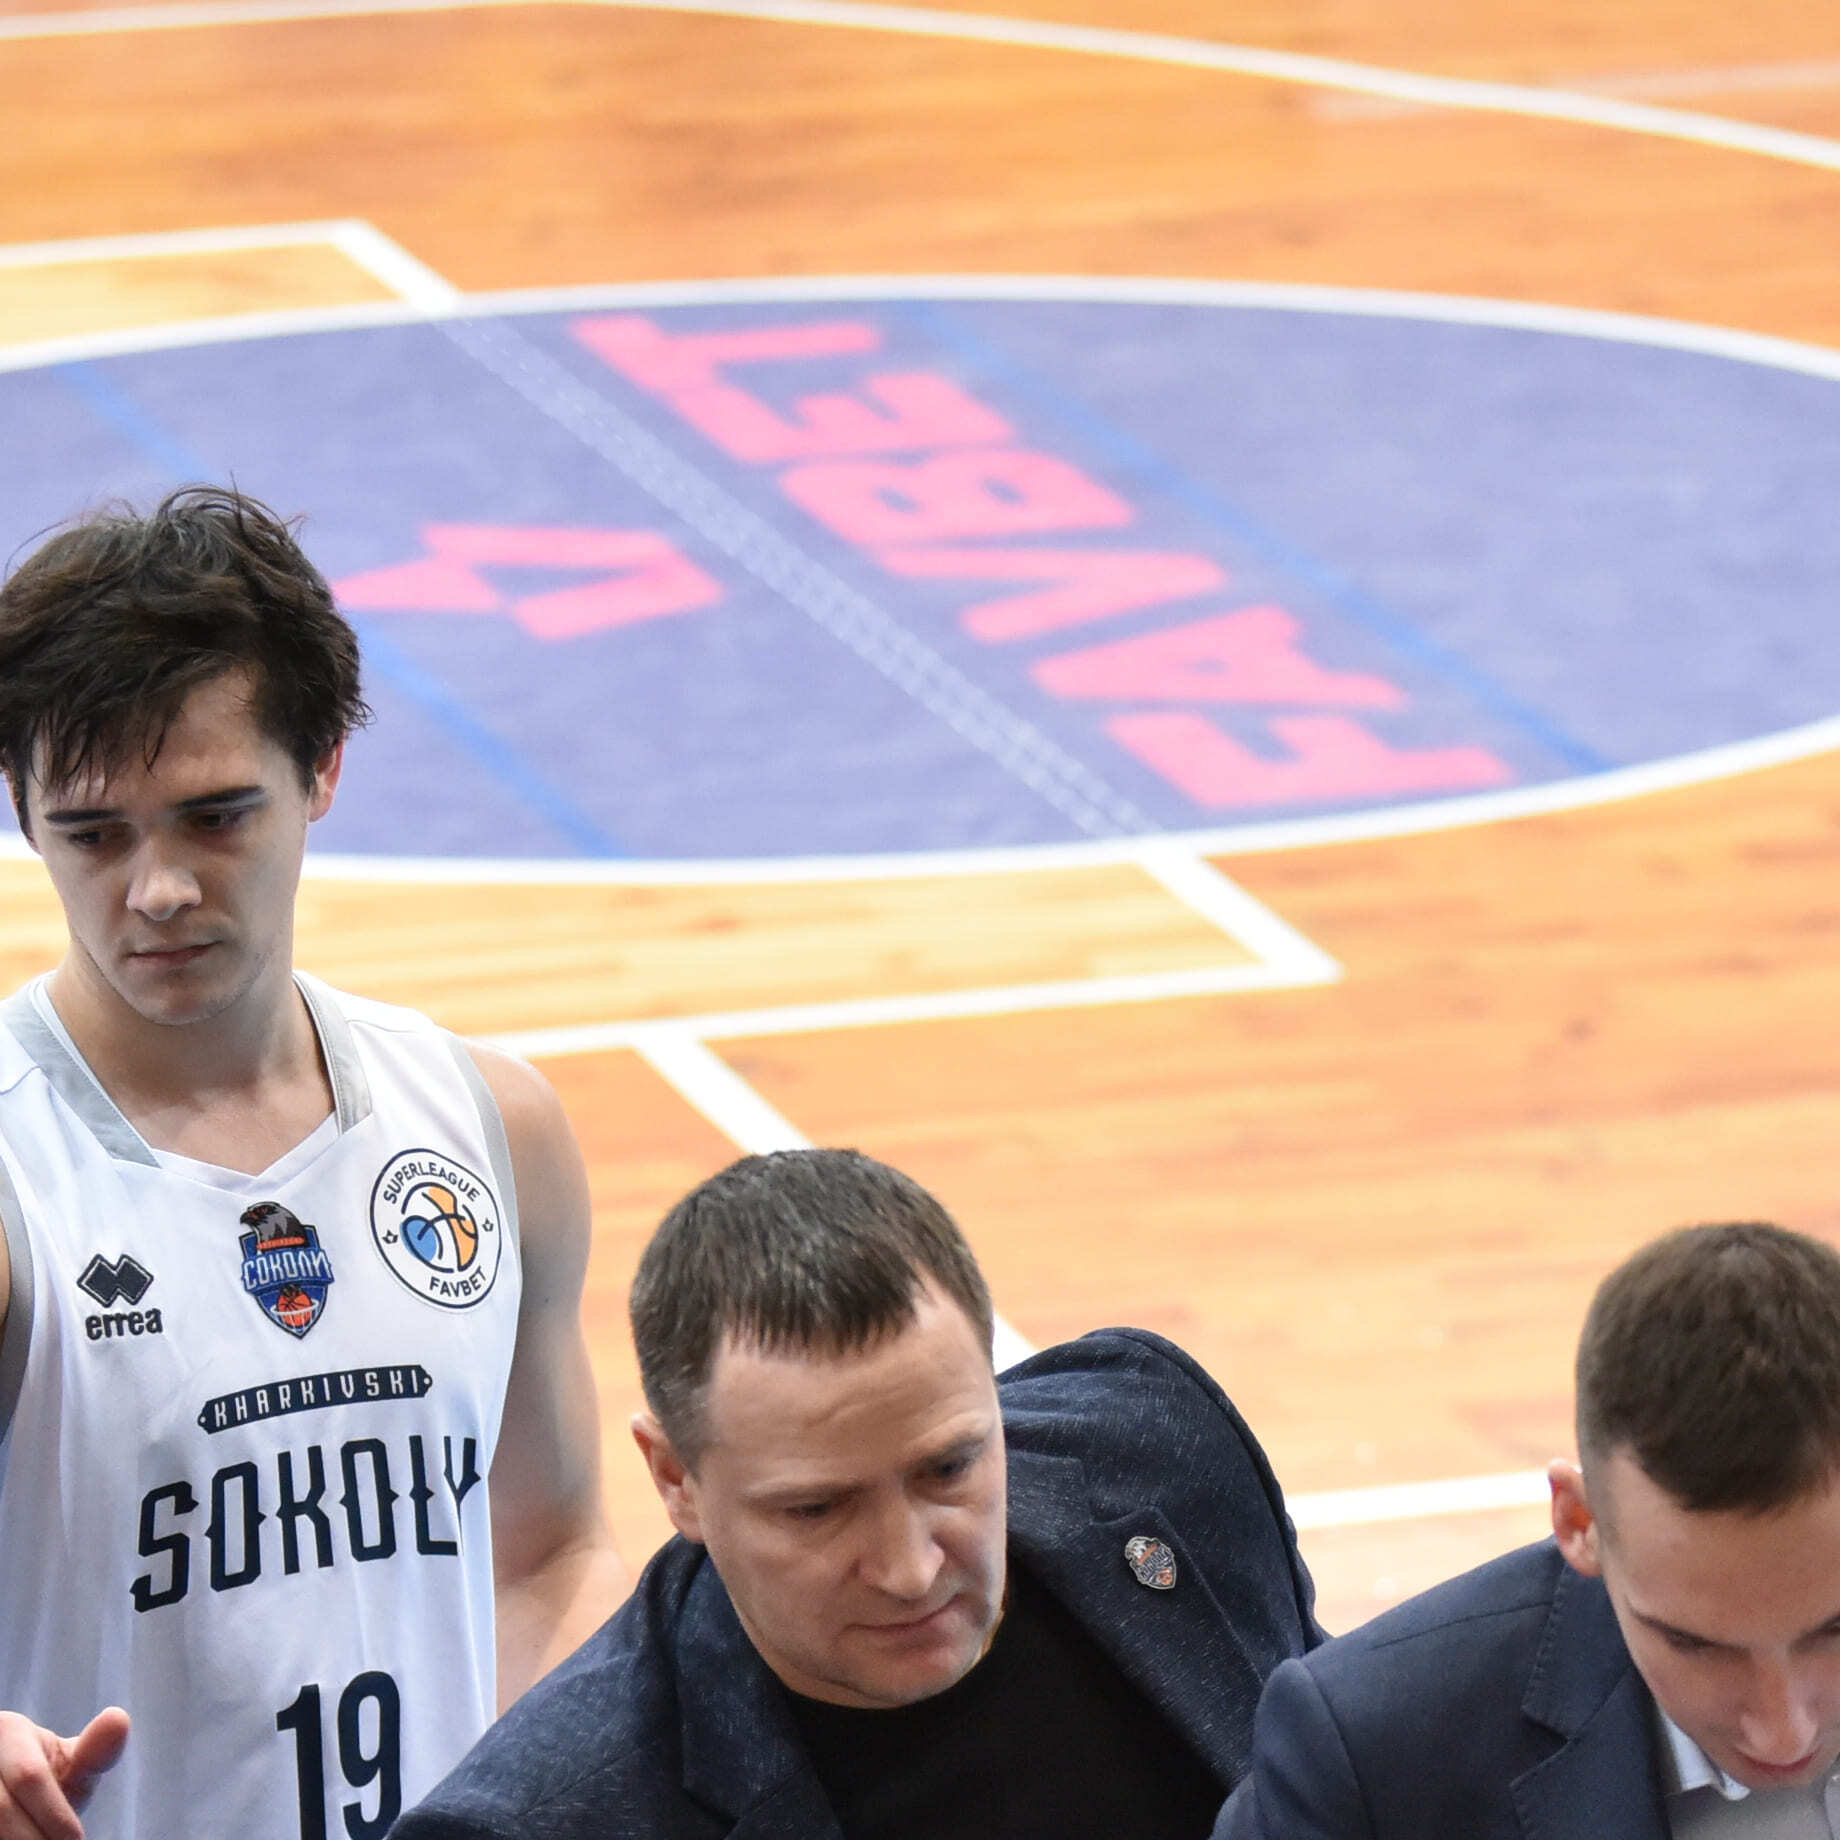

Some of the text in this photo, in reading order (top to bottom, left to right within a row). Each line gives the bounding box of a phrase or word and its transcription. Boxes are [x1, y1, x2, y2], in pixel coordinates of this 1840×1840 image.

[568, 315, 1516, 809] FAVBET
[383, 1161, 481, 1205] SUPERLEAGUE
[429, 1265, 486, 1298] FAVBET
[214, 1368, 419, 1427] KHARKIVSKI
[130, 1435, 481, 1613] SOKOLY
